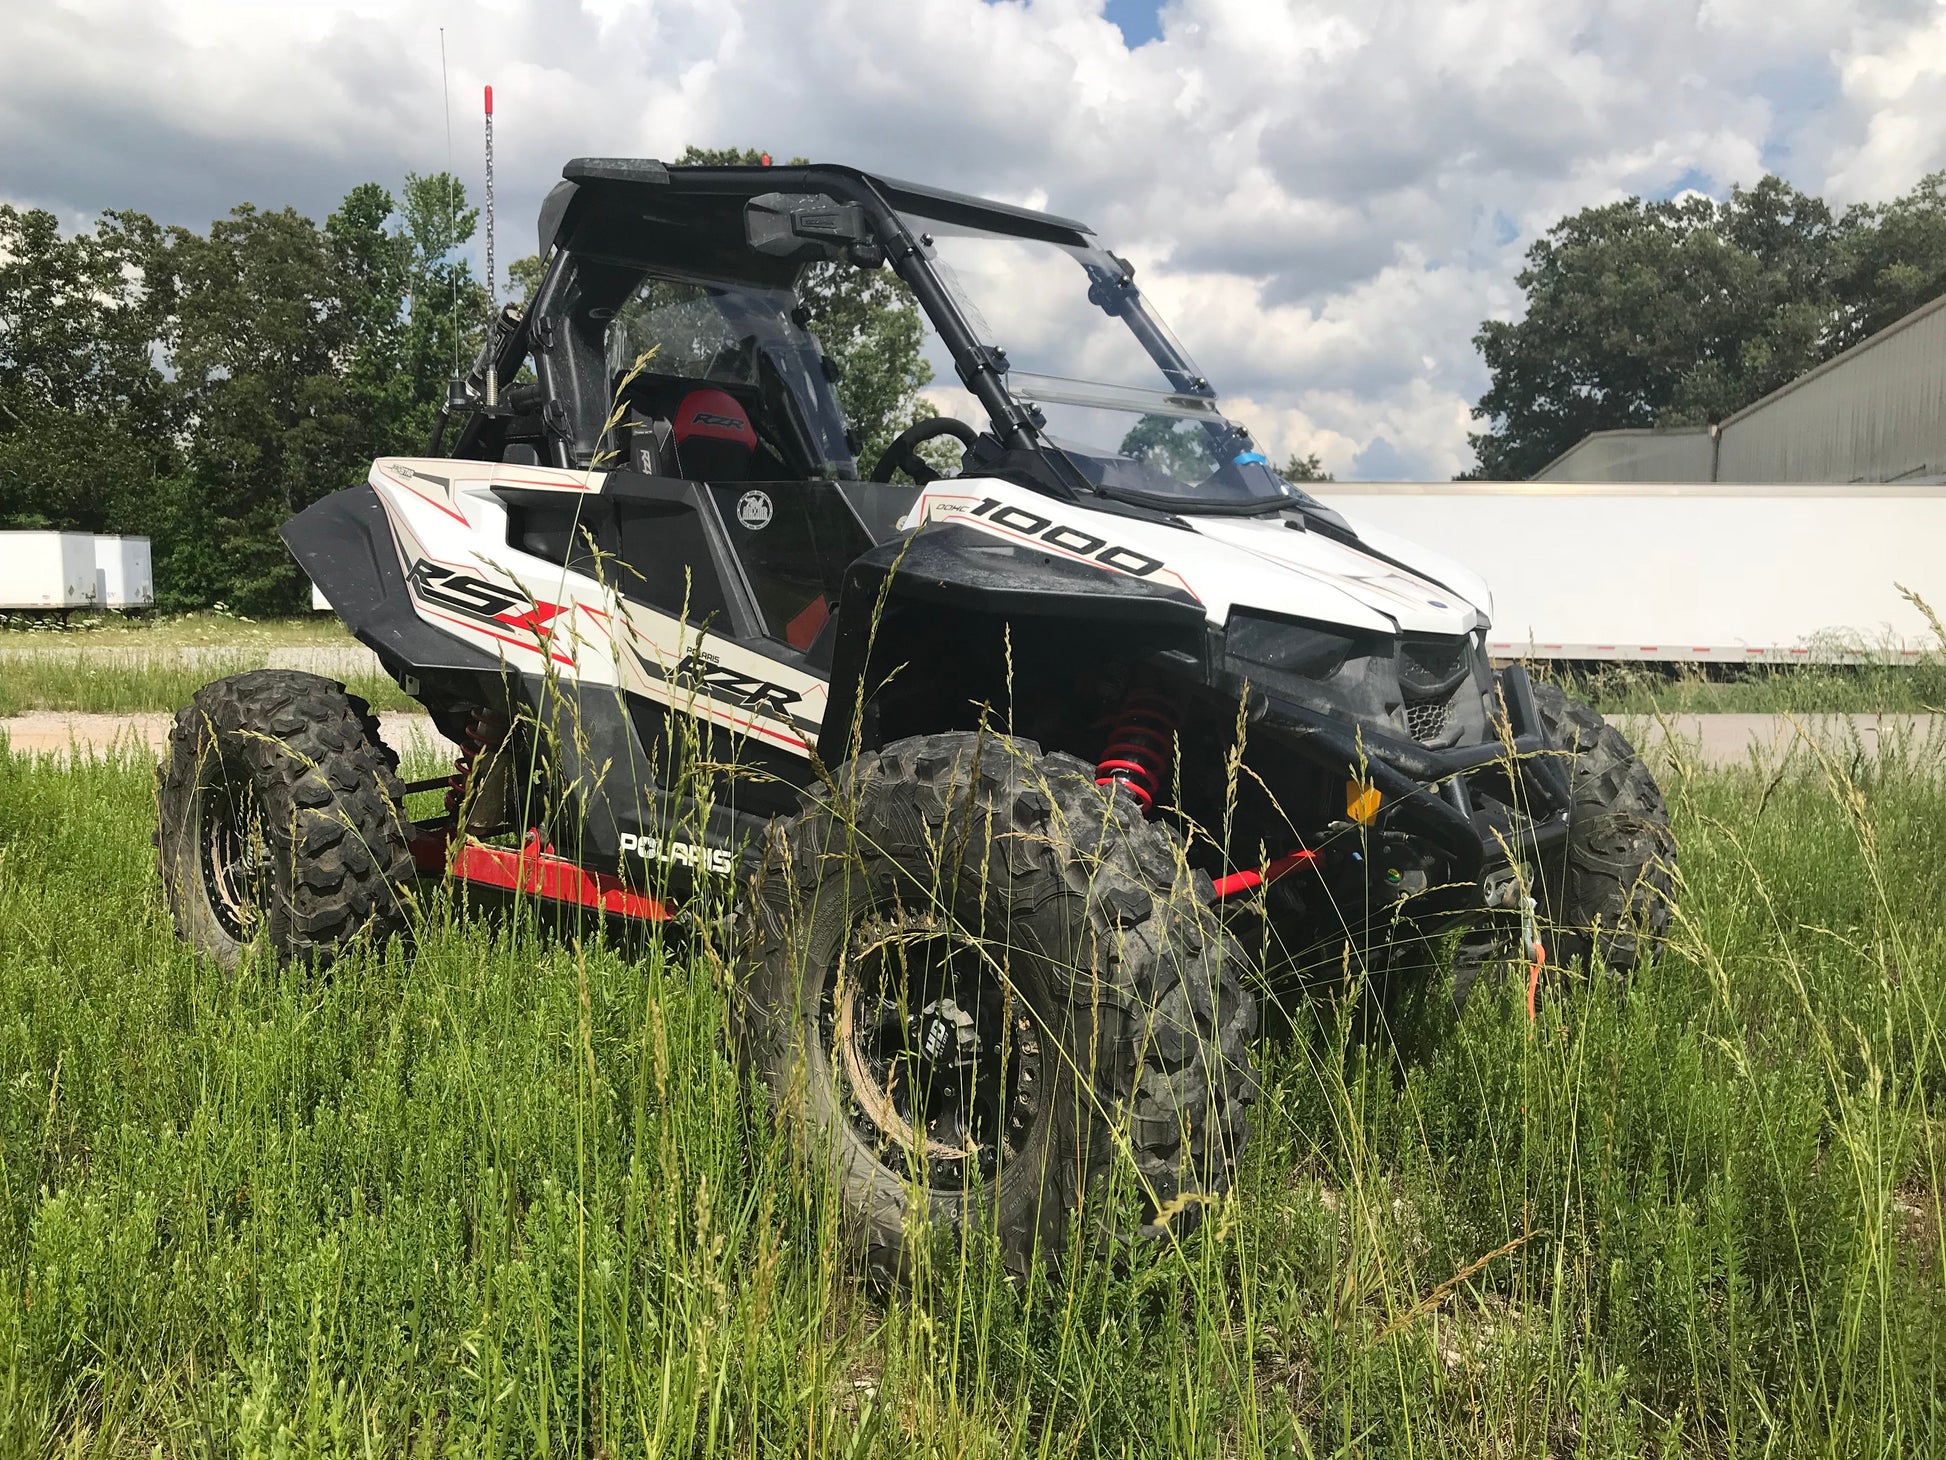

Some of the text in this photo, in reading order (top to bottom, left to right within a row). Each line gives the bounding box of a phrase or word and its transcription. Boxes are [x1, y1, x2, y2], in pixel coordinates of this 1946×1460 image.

[691, 412, 745, 431] RZR
[936, 503, 970, 513] DOHC
[969, 497, 1165, 577] 1000
[406, 557, 571, 641] RS1
[686, 646, 720, 664] POARIS
[665, 655, 803, 719] RZR
[620, 832, 732, 874] POLARIS
[925, 1018, 946, 1058] HD
